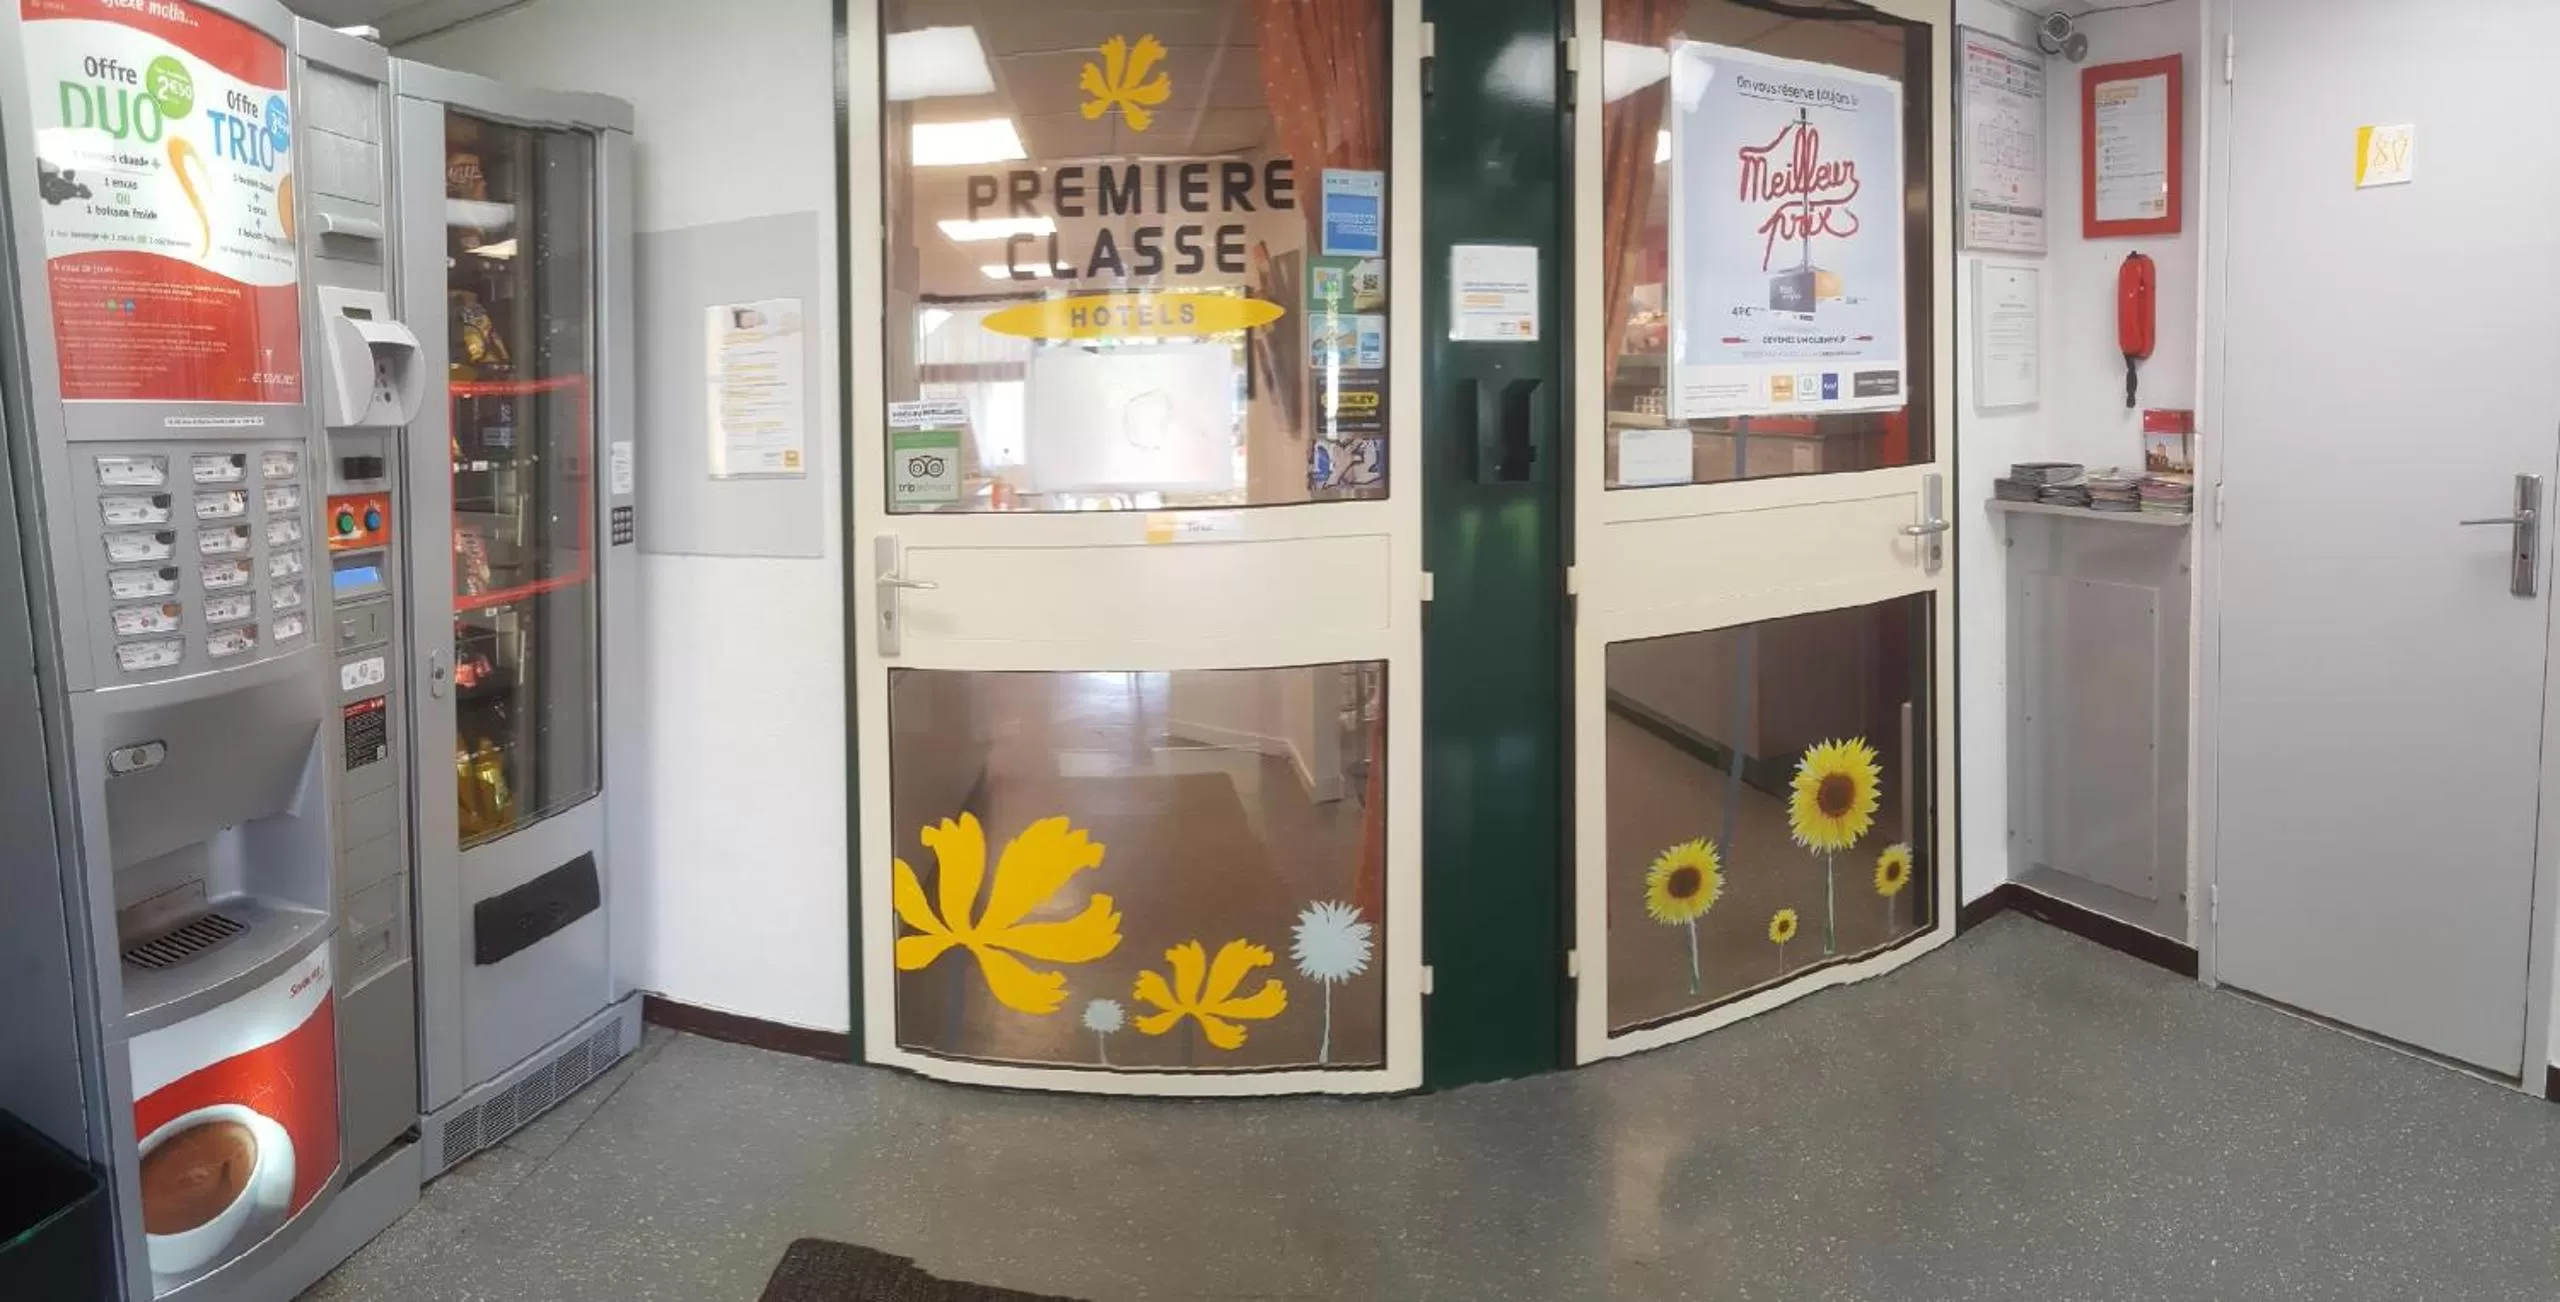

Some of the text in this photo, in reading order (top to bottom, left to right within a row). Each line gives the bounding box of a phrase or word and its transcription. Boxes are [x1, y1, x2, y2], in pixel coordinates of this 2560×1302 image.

[84, 56, 137, 85] Offre
[1751, 79, 1777, 94] vous
[59, 79, 163, 144] DUO
[227, 89, 259, 118] Offre
[207, 108, 274, 172] TRIO
[1738, 126, 1860, 203] Meilleur
[967, 160, 1296, 222] PREMIERE
[1006, 224, 1247, 281] CLASSE
[1758, 201, 1860, 272] prix
[1070, 303, 1196, 328] HOTELS
